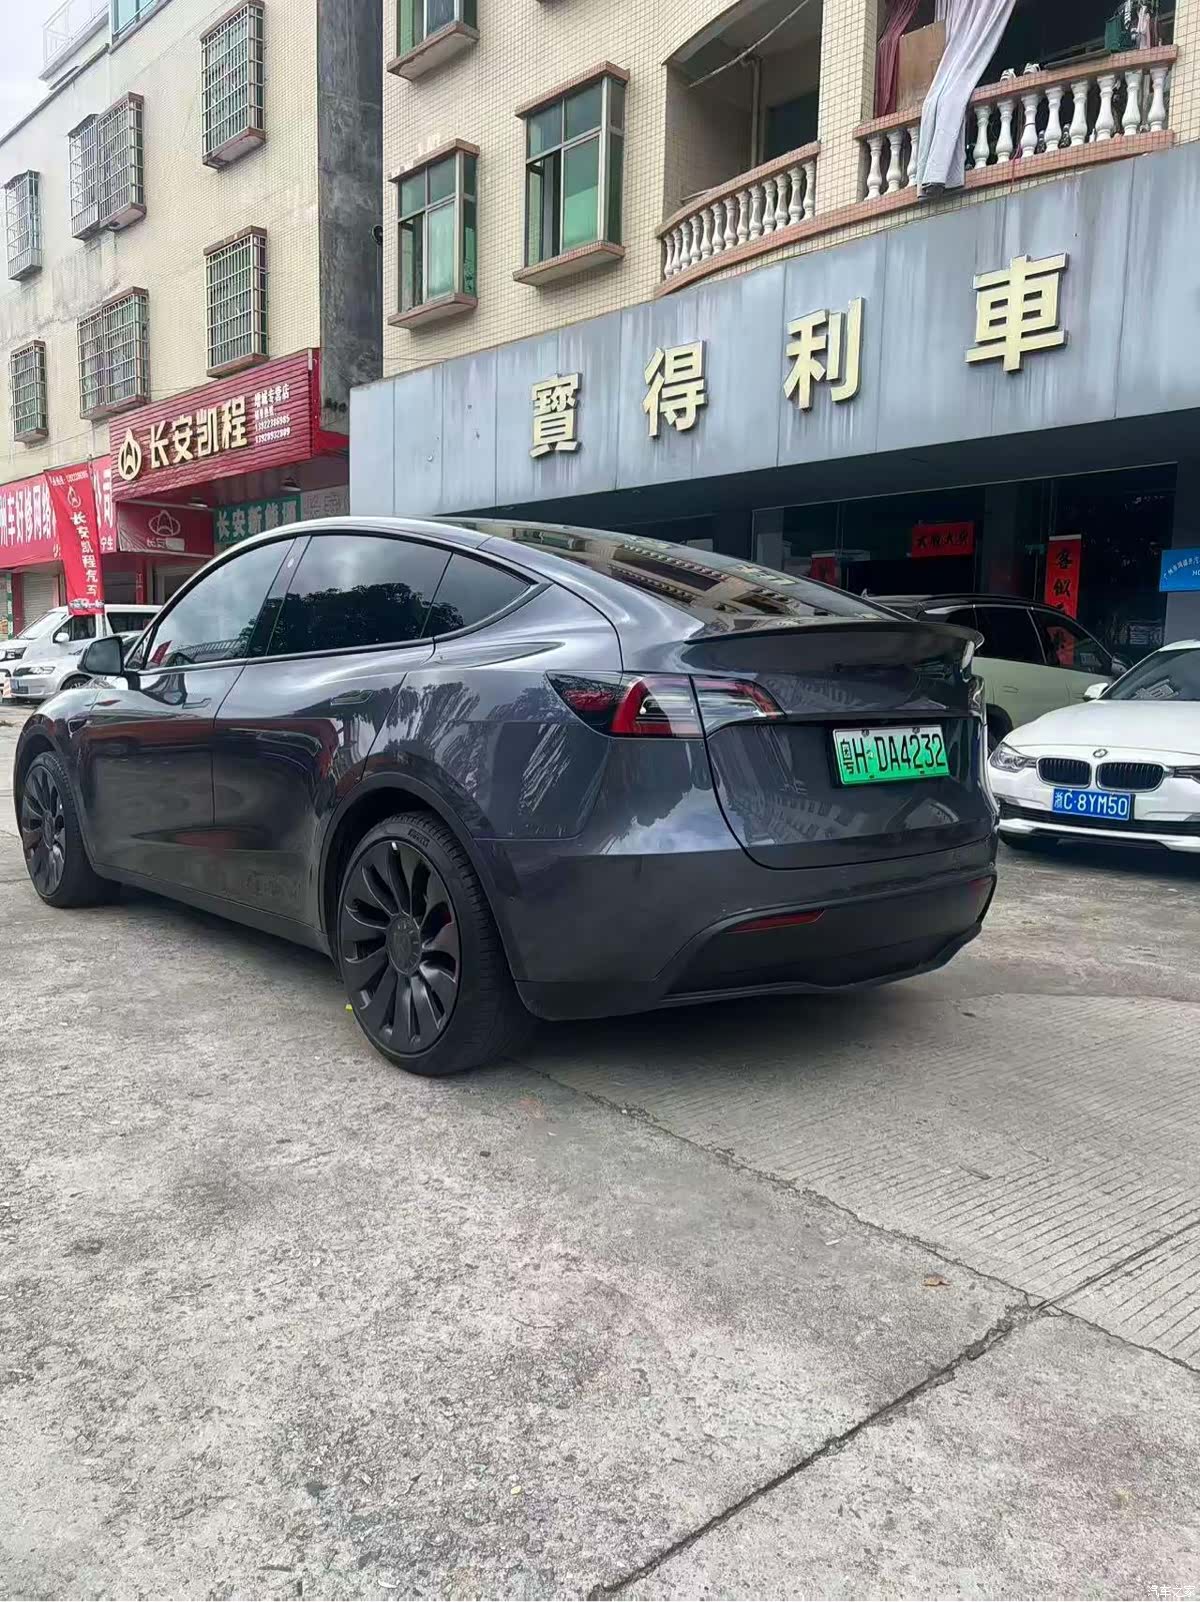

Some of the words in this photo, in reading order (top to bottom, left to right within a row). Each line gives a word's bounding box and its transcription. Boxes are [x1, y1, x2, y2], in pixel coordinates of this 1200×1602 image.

[529, 251, 1069, 459] 寶得利車
[150, 396, 248, 468] 长安凯程
